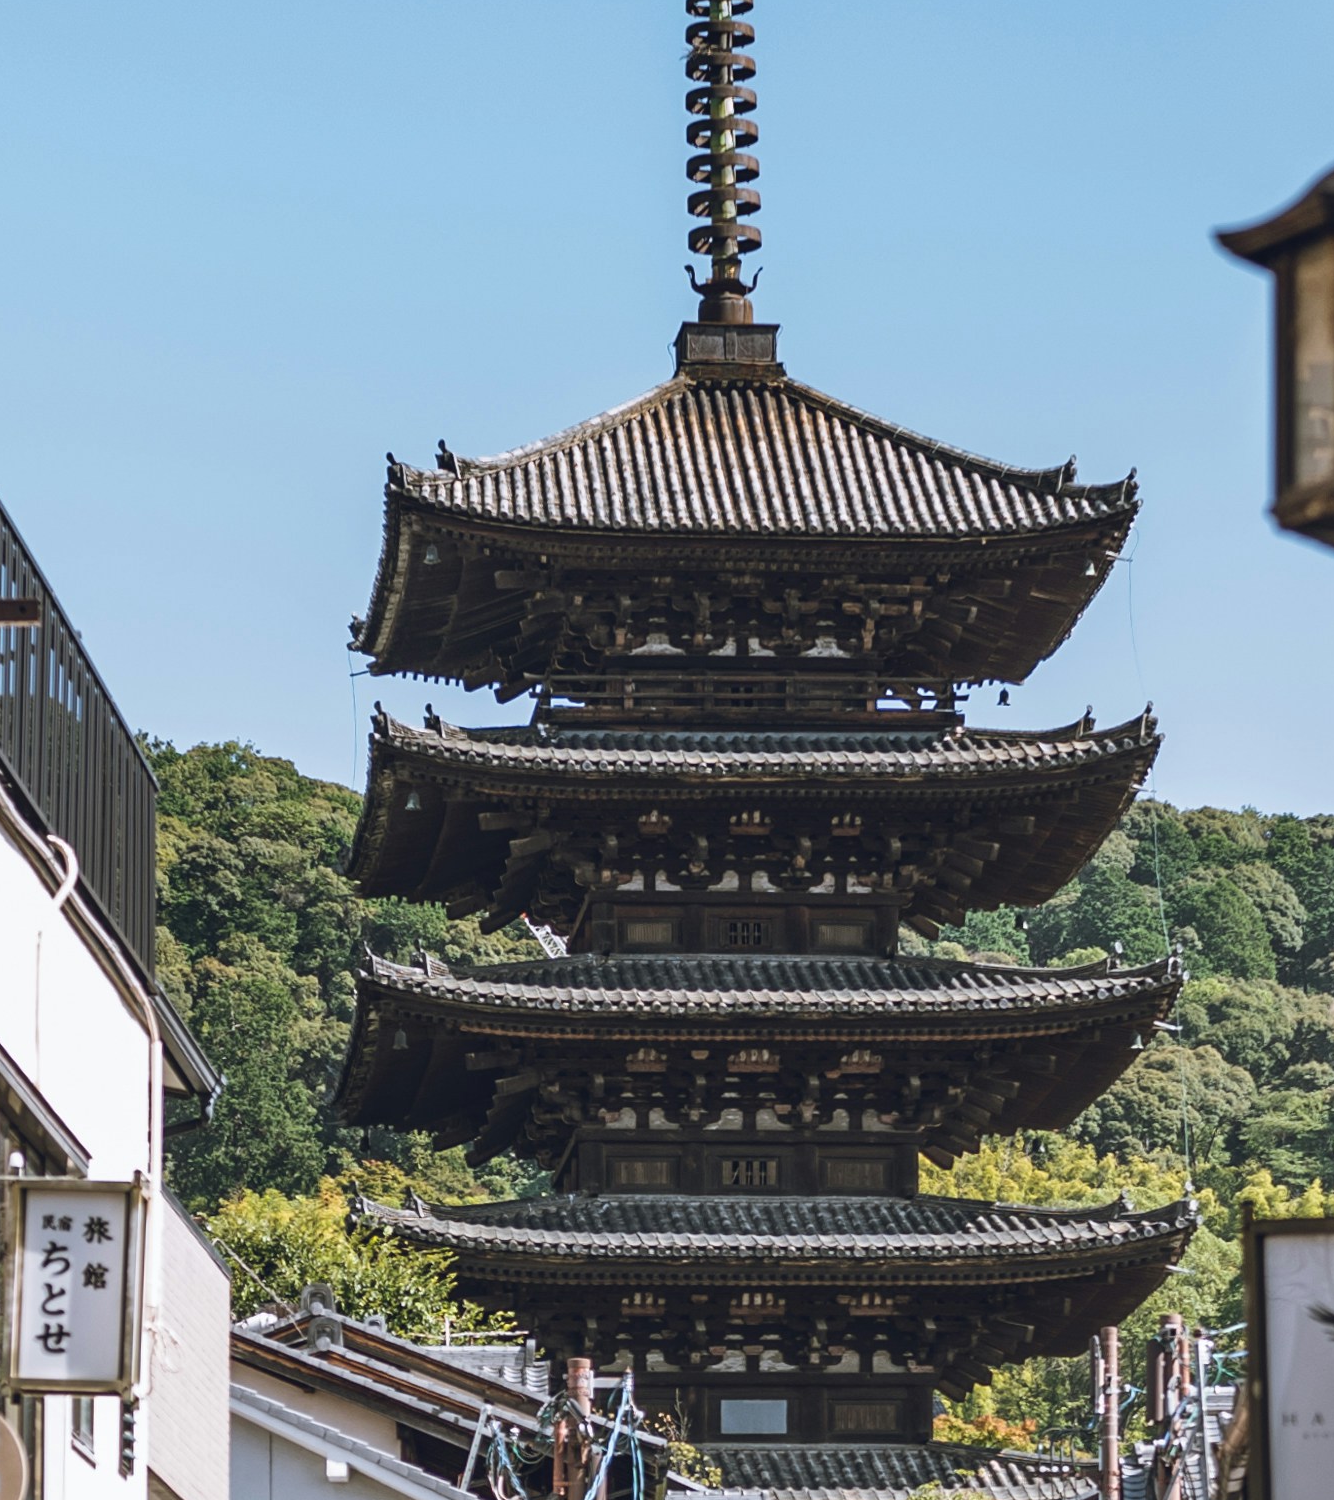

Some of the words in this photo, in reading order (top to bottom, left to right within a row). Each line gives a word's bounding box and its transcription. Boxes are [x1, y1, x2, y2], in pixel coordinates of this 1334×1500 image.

[42, 1214, 72, 1232] 民宿
[82, 1216, 113, 1290] 旅館
[36, 1240, 71, 1354] ちとせ
